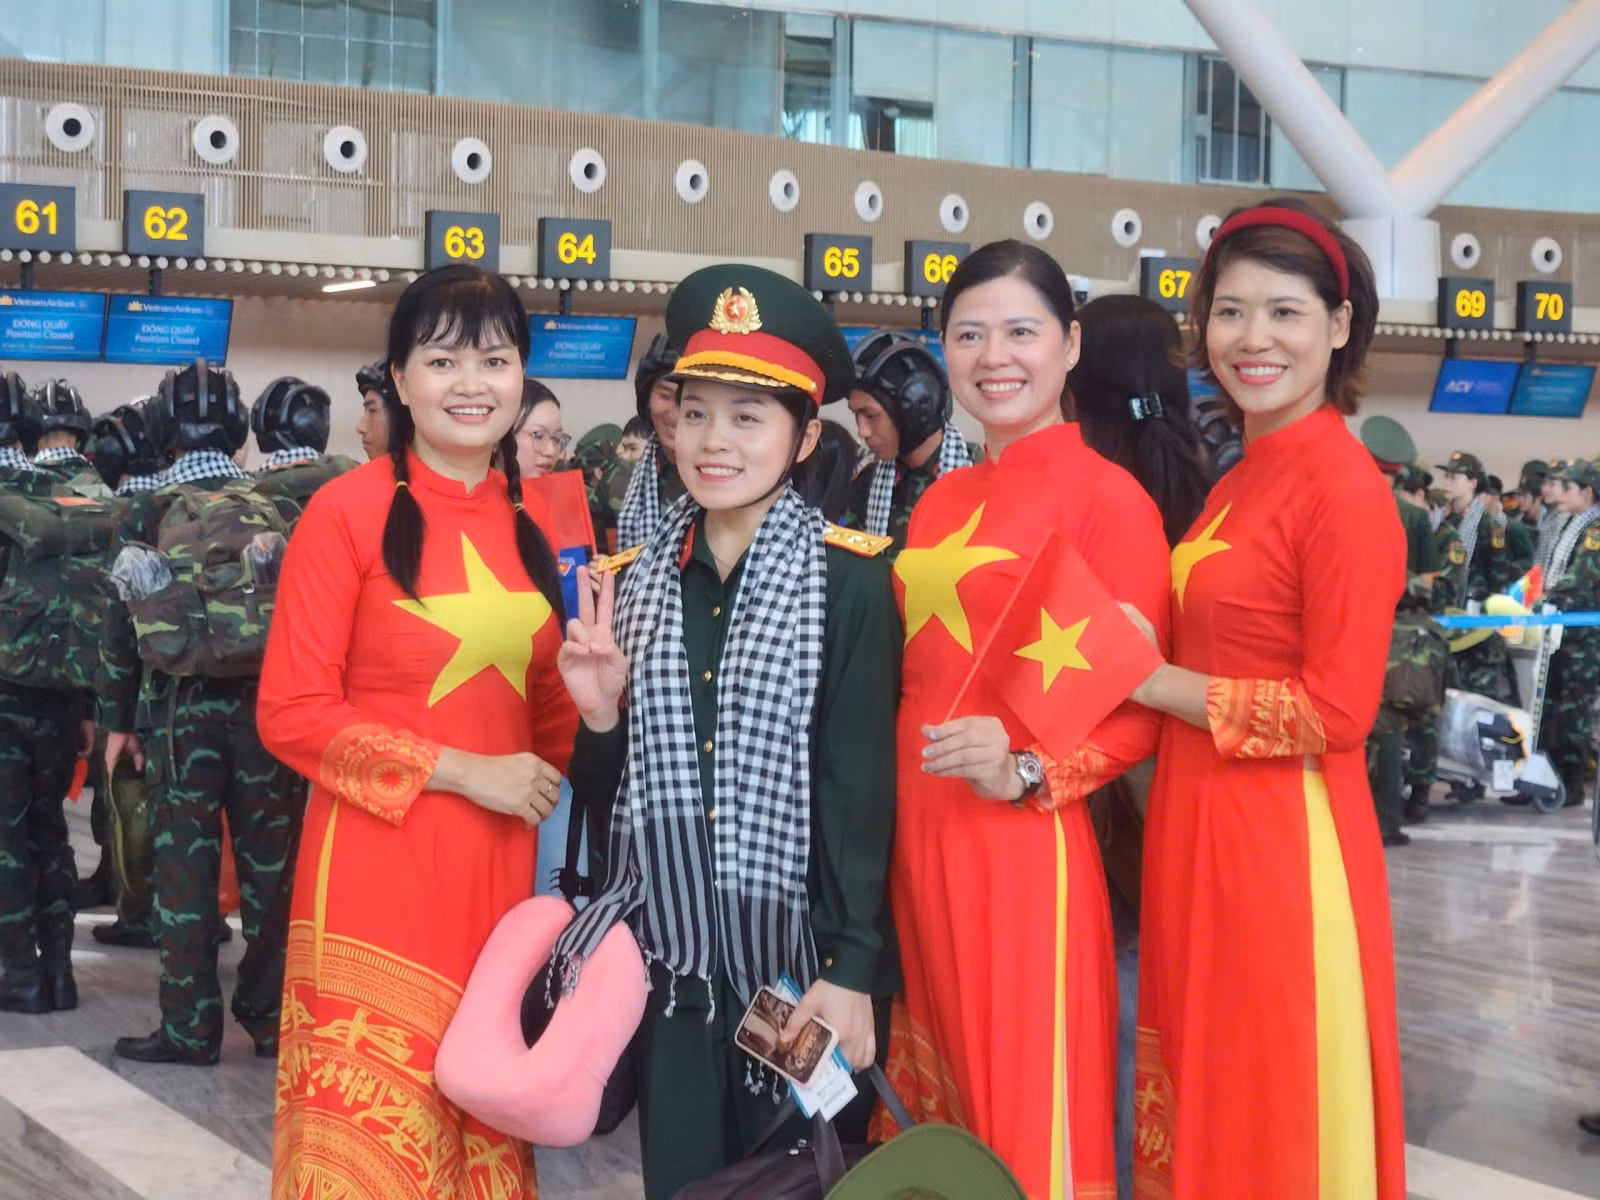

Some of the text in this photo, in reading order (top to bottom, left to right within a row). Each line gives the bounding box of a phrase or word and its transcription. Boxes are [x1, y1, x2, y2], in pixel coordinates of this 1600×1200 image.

[15, 200, 57, 235] 61
[143, 206, 189, 241] 62
[444, 226, 485, 259] 63
[557, 232, 597, 265] 64
[823, 248, 860, 279] 65
[1159, 269, 1192, 299] 67
[1455, 289, 1487, 317] 69
[1535, 293, 1564, 321] 70
[1445, 379, 1474, 393] ACV
